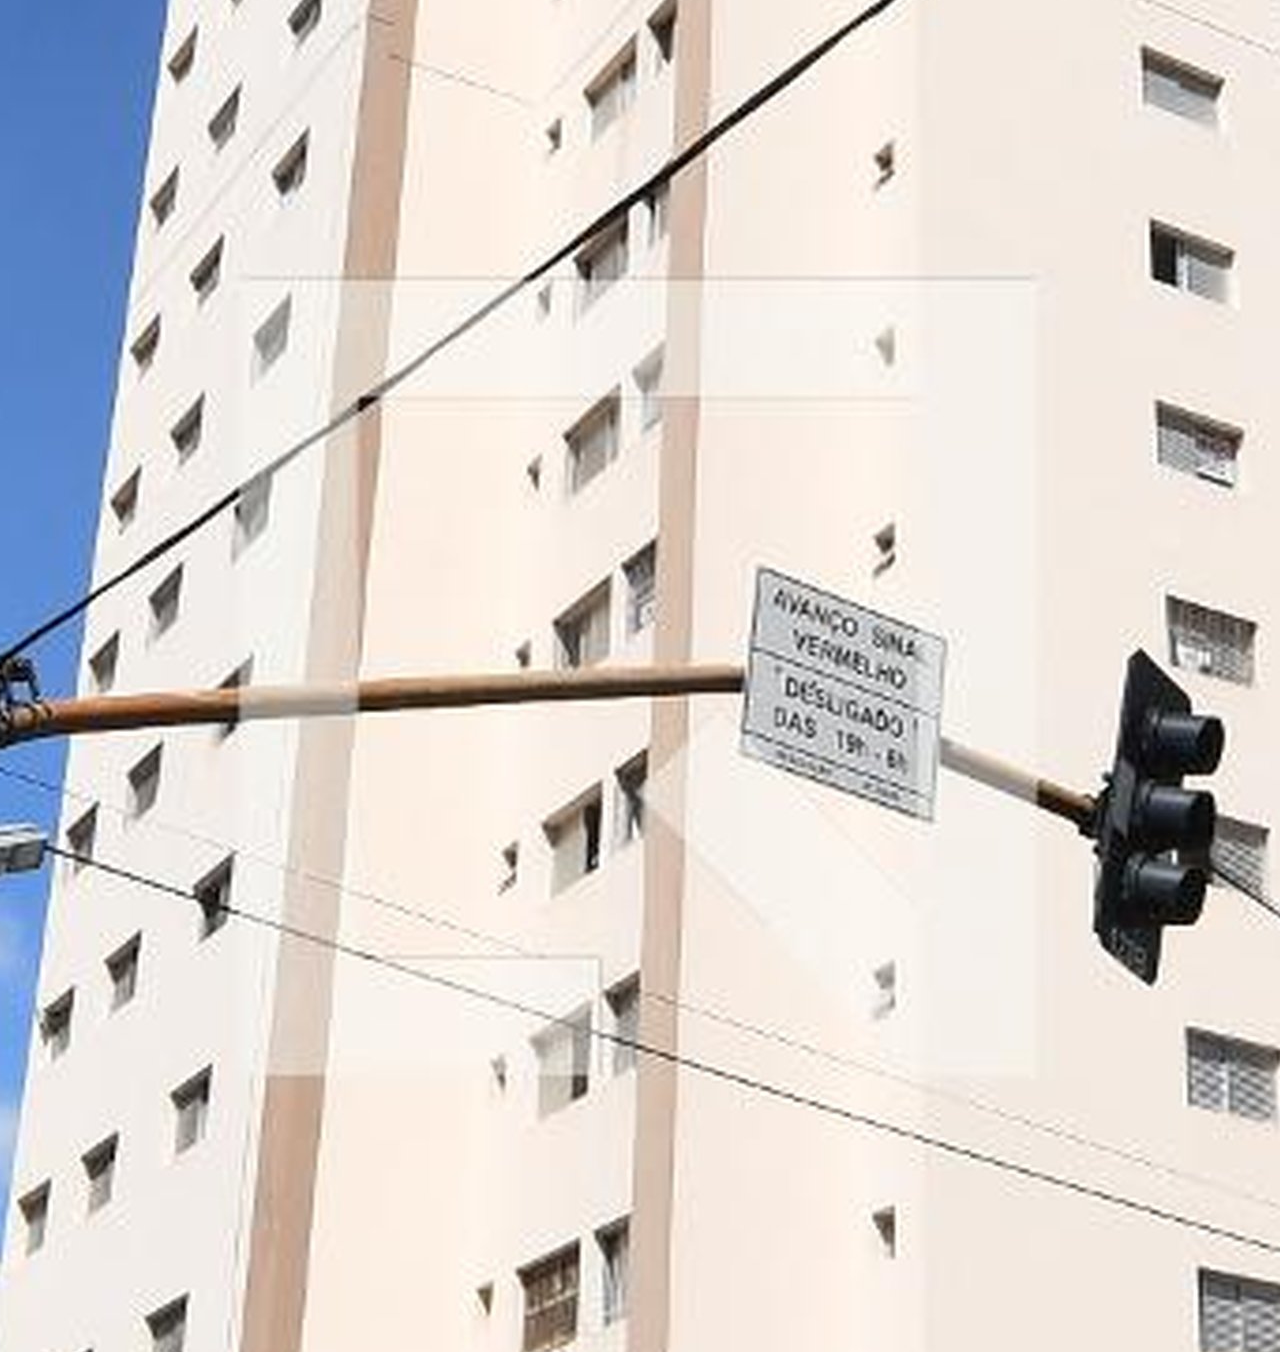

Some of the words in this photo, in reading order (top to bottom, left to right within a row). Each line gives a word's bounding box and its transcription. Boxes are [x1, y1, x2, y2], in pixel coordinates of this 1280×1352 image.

[792, 628, 908, 690] VERMELHO
[871, 626, 923, 661] SINA
[774, 706, 817, 739] DAS
